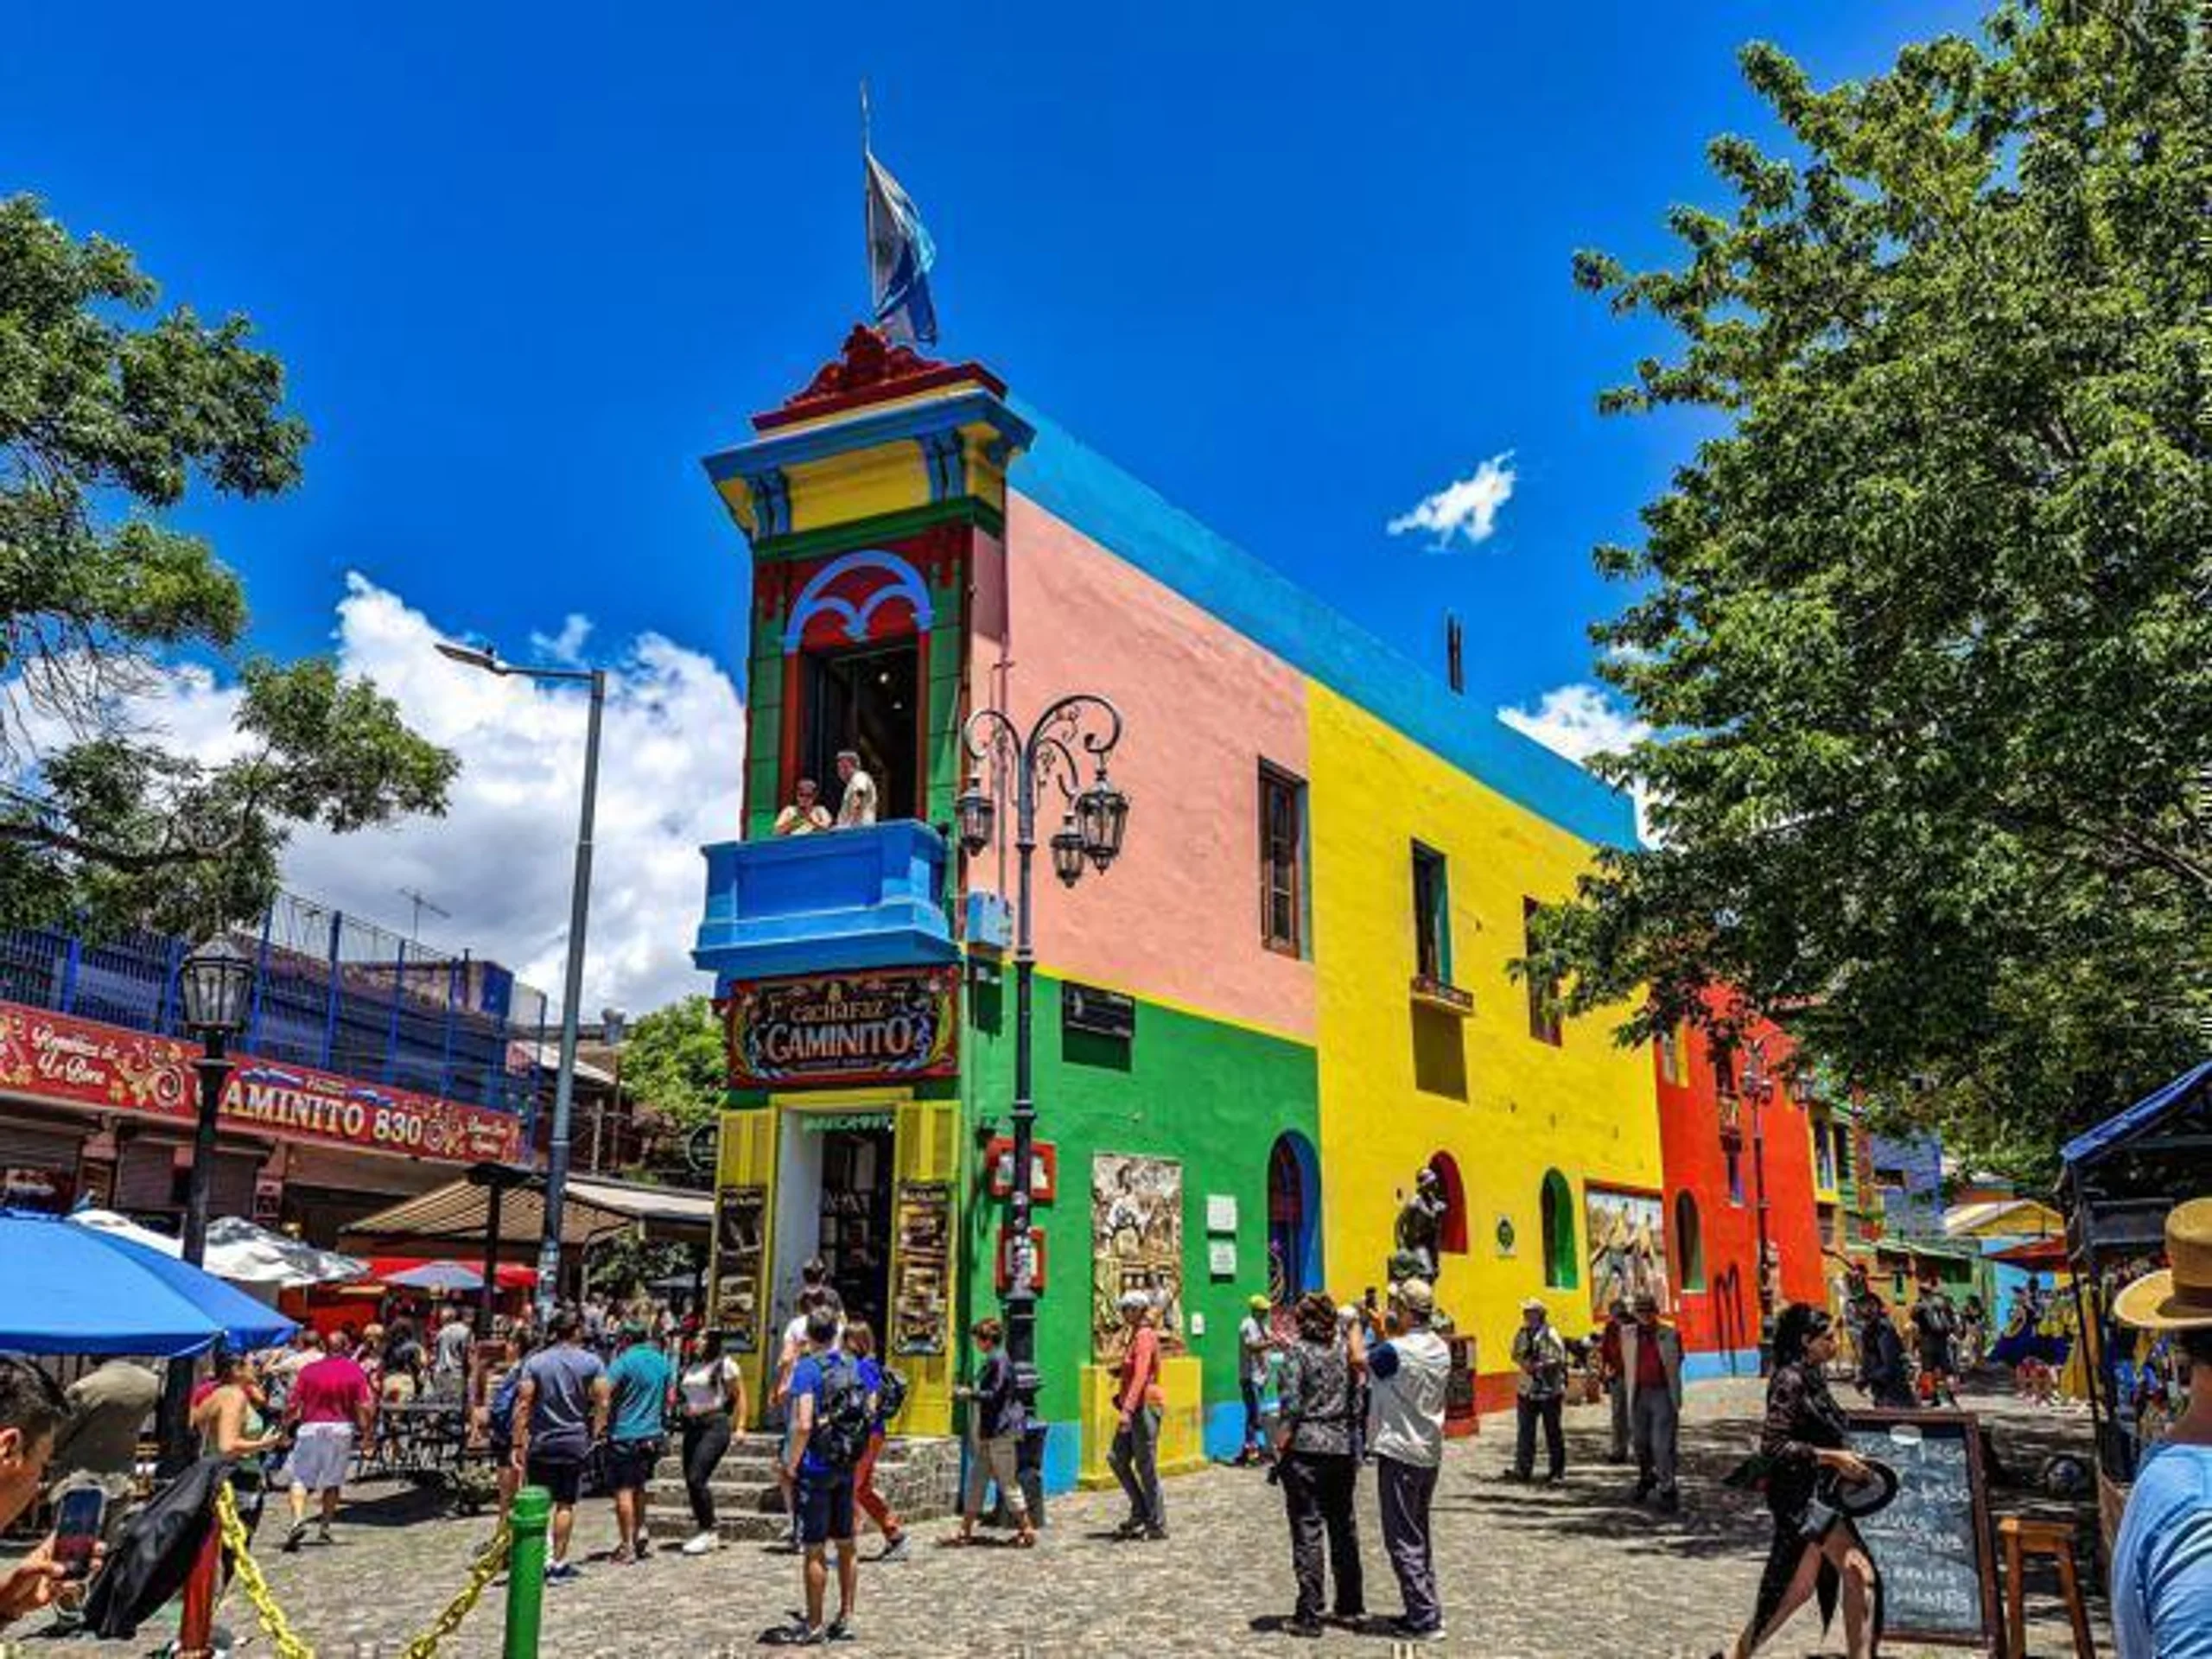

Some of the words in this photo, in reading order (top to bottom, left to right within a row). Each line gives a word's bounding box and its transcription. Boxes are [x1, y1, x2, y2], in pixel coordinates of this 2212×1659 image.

[766, 1016, 912, 1065] CAMINITO
[194, 1080, 365, 1136] AMINITO
[372, 1109, 422, 1146] 830
